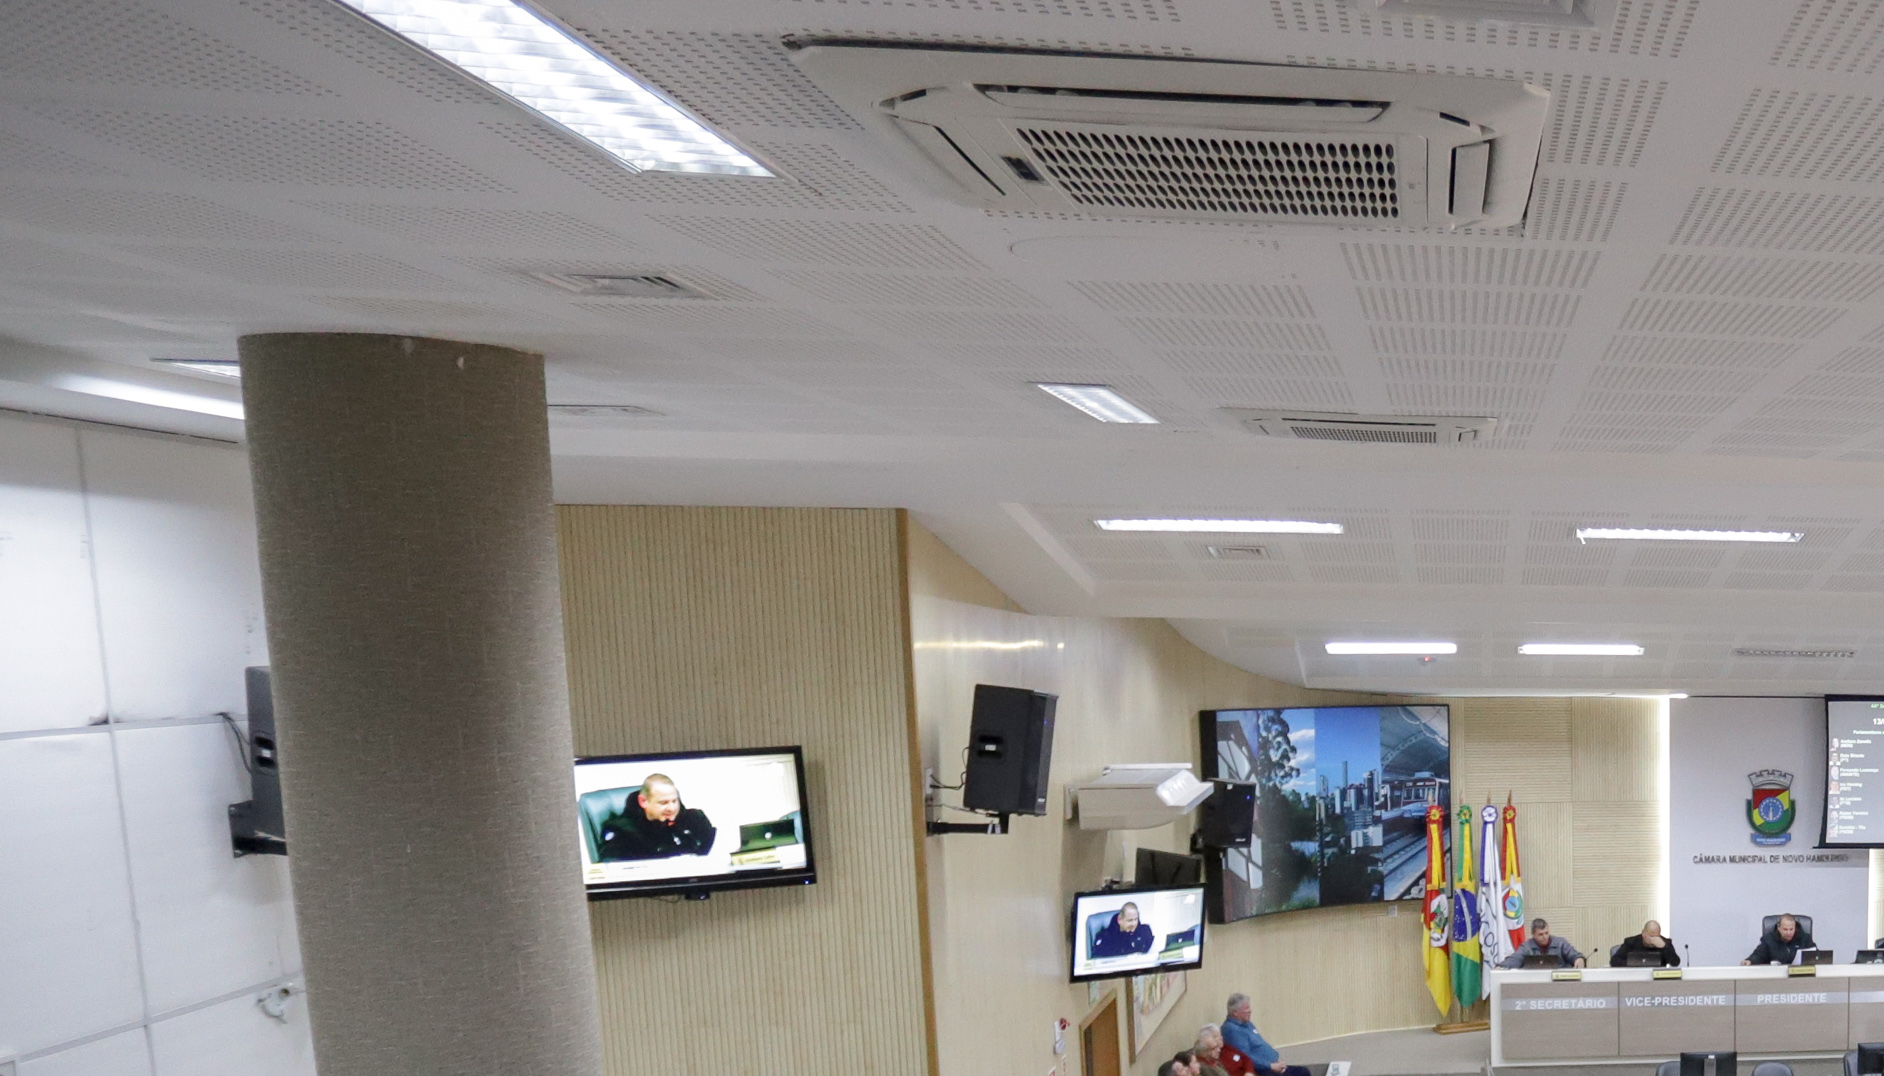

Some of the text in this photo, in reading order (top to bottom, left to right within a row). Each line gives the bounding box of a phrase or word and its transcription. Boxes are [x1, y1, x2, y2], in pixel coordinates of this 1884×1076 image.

[1693, 853, 1727, 864] CÂMARA
[1728, 854, 1768, 864] MUNICIPAL
[1769, 854, 1780, 863] DE
[1782, 854, 1805, 863] NOVO
[1529, 998, 1606, 1010] SECRETÁRIO
[1625, 995, 1726, 1007] VICE-PRESIDENTE
[1757, 993, 1827, 1004] PRESIDENTE
